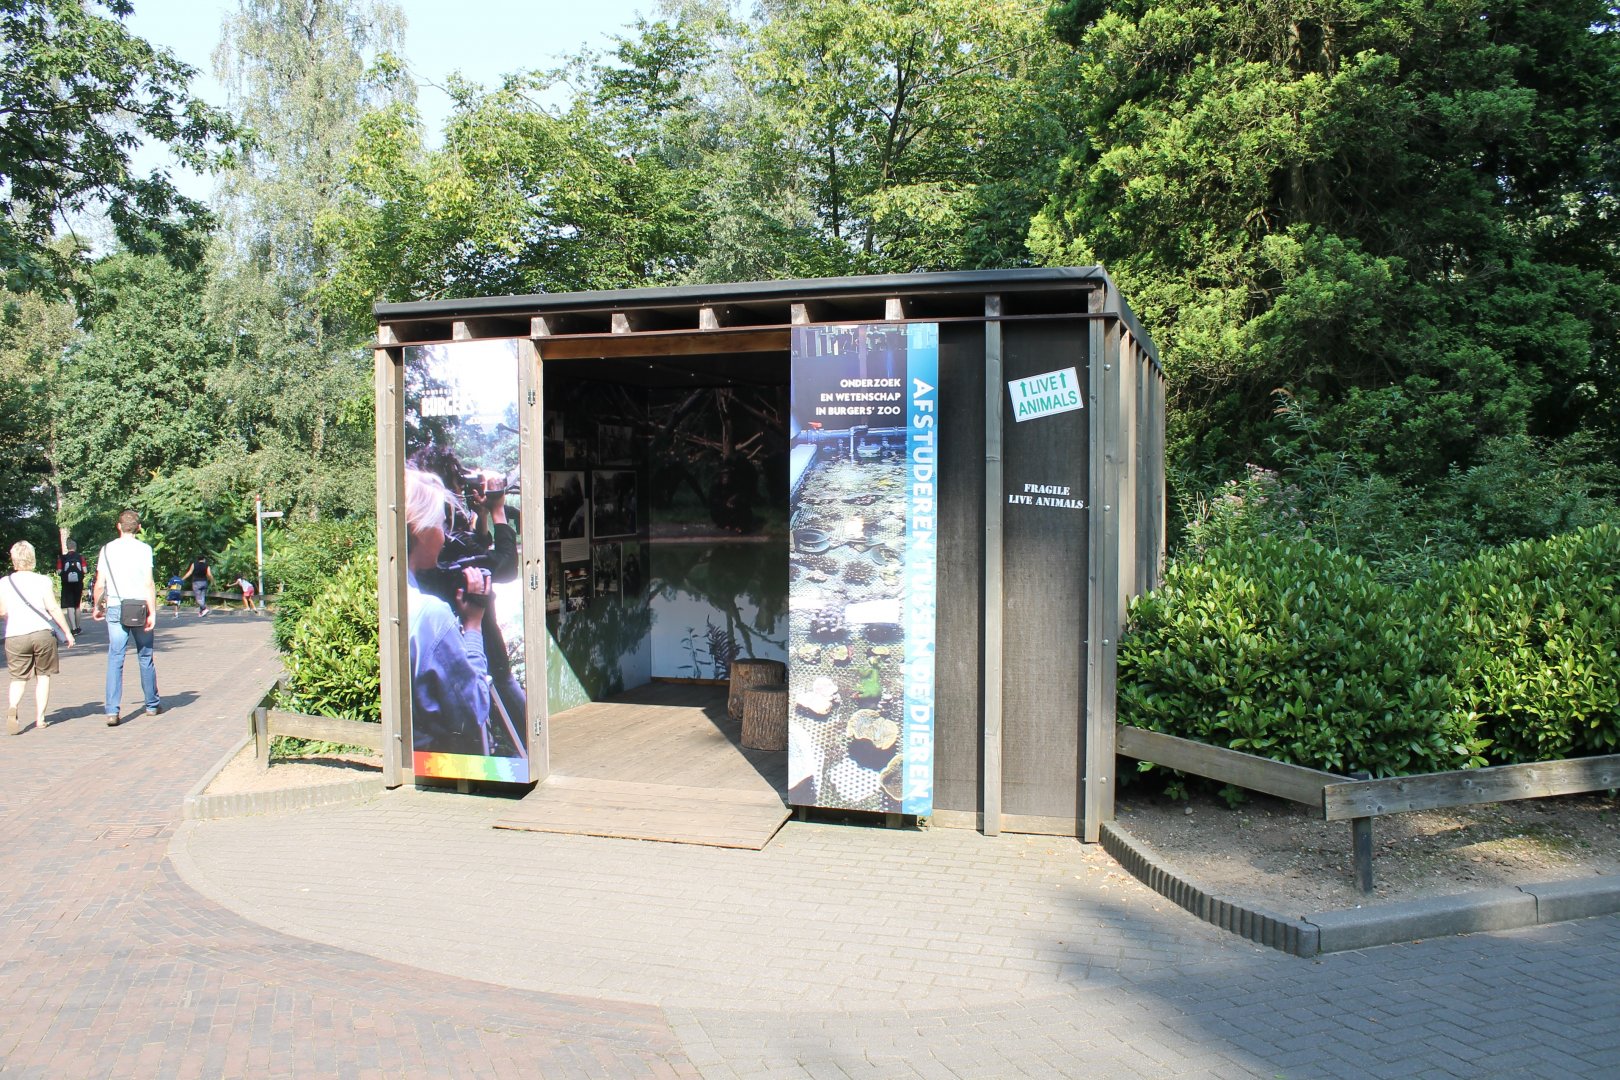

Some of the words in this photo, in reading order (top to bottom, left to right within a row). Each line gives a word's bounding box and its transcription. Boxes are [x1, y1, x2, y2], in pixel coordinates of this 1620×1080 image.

[840, 378, 901, 388] ONDERZOEK
[1029, 376, 1058, 395] LIVE
[820, 393, 833, 402] EN
[835, 392, 901, 402] WETENSCHAP
[1019, 391, 1078, 416] ANIMALS
[815, 407, 828, 416] IN
[877, 406, 901, 415] ZOO
[912, 378, 935, 550] AFSTUDEREN
[1024, 483, 1070, 496] FRAGILE
[1008, 494, 1033, 505] LIVE
[1035, 497, 1084, 509] ANIMALS
[911, 559, 933, 657] TUSSEN
[910, 660, 931, 699] DE
[908, 704, 931, 798] DIEREN
